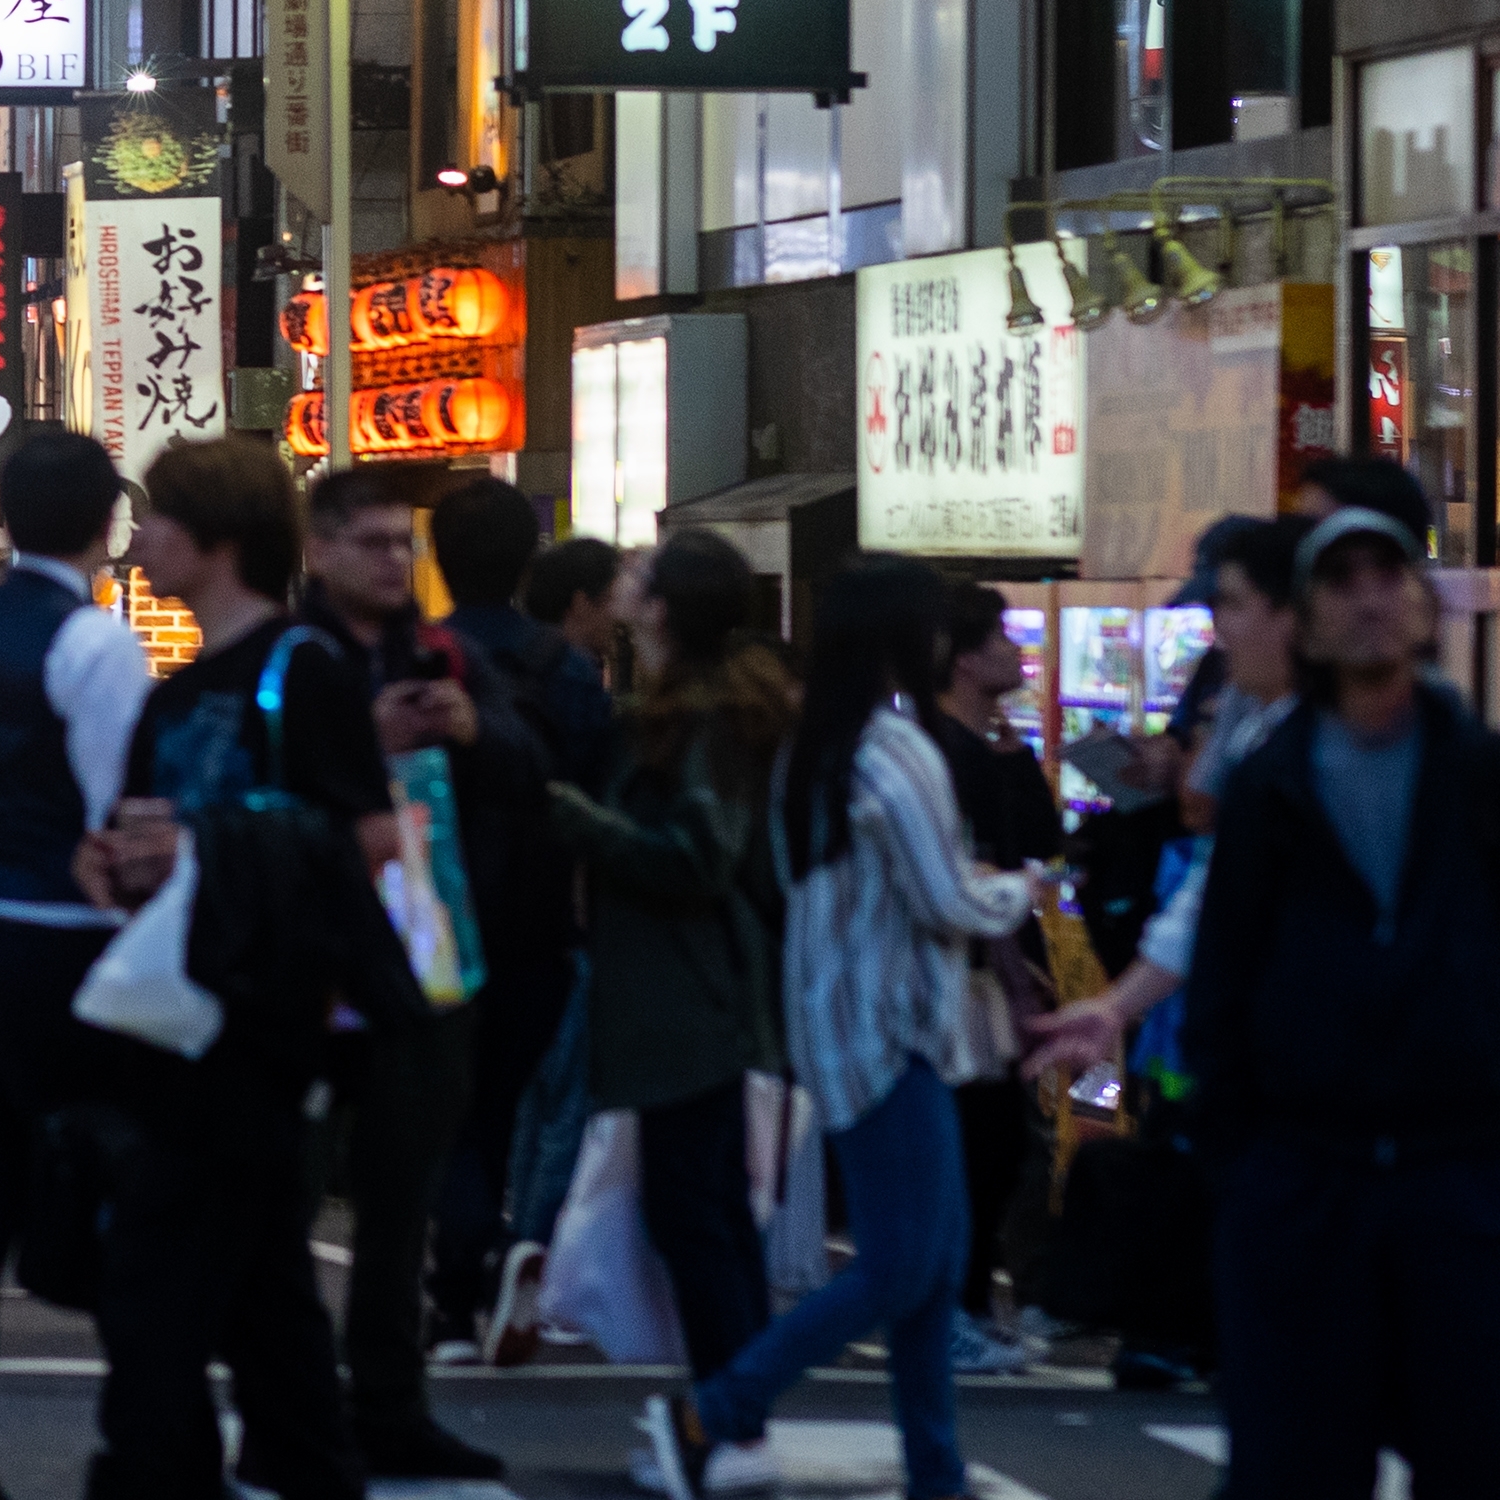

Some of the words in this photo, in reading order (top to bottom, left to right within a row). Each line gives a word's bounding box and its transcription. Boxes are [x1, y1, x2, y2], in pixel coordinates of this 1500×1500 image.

[15, 52, 80, 82] B1F
[99, 225, 121, 325] HIROSHIMA
[133, 222, 219, 445] お好み焼
